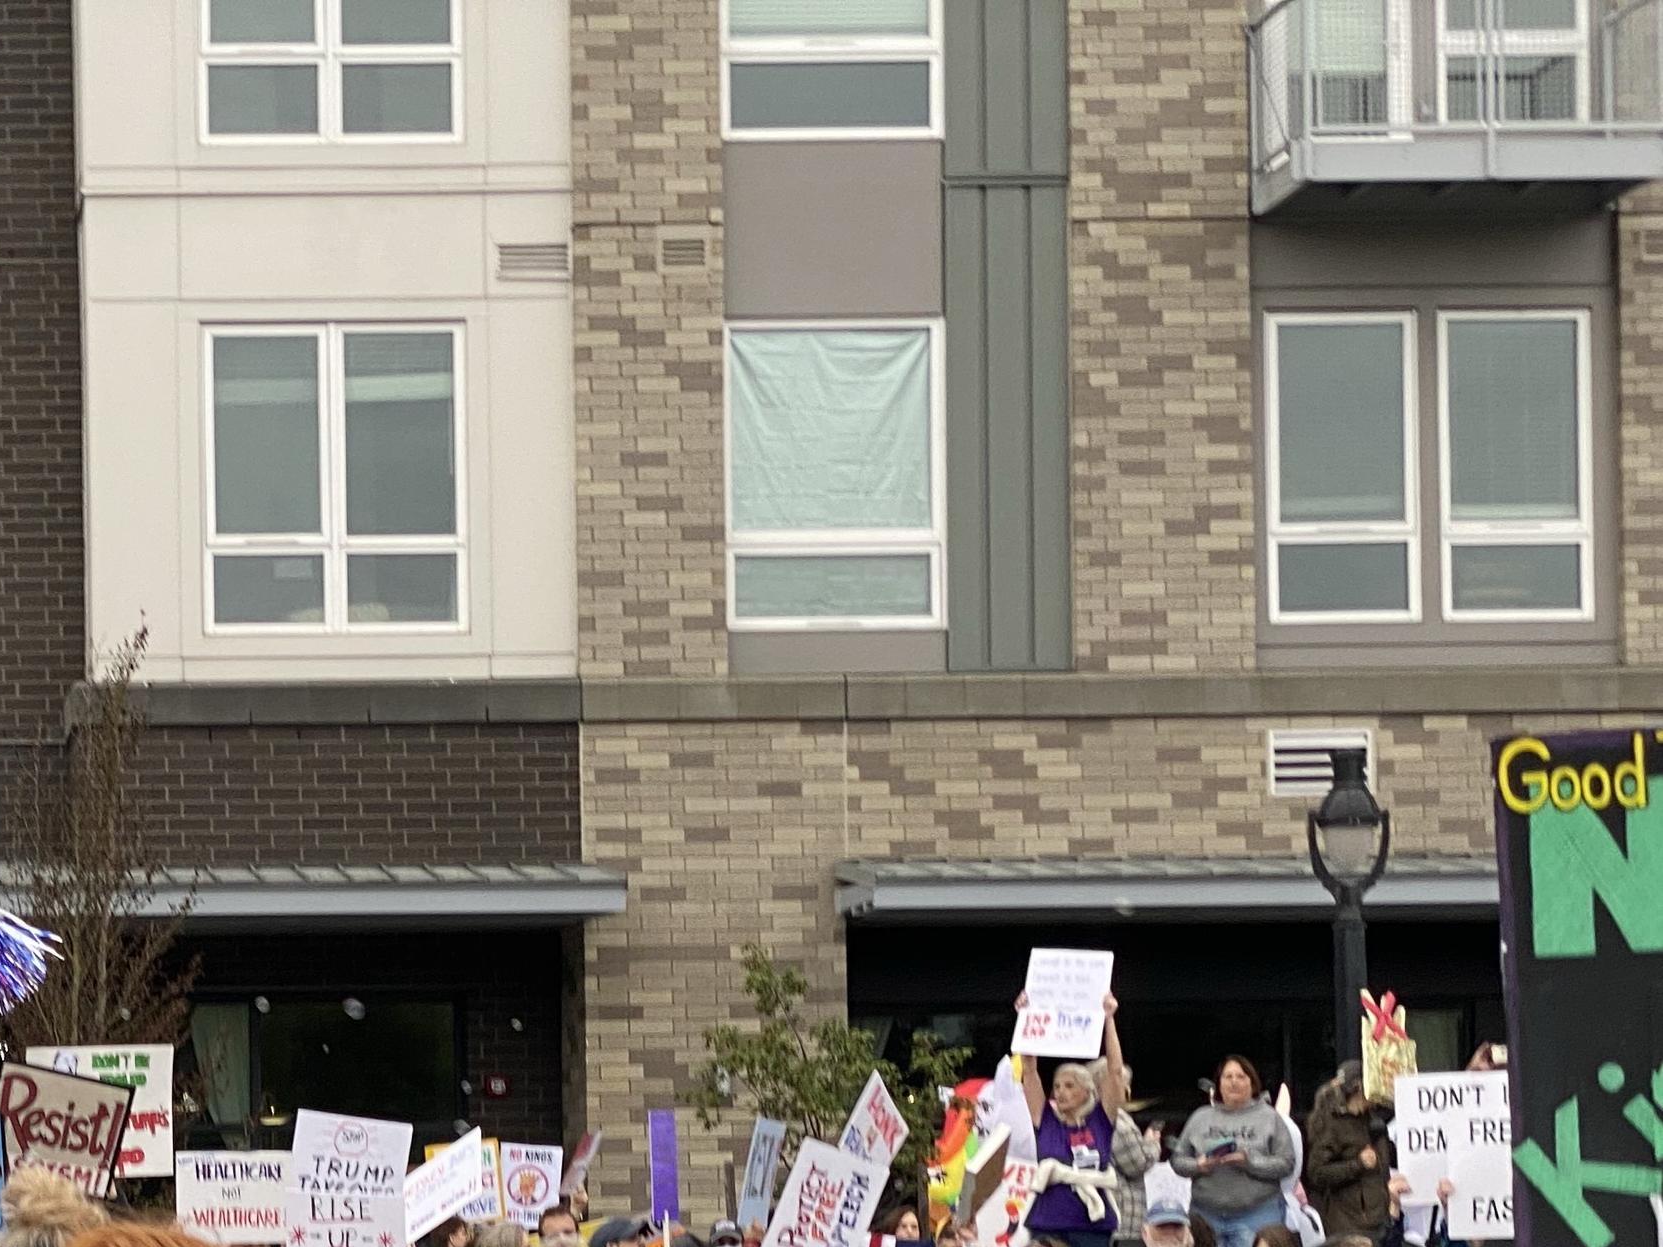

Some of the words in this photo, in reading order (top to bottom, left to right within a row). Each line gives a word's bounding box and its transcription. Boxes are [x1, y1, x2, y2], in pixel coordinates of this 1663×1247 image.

[1497, 731, 1648, 814] Good
[1417, 1083, 1485, 1112] DON'T
[0, 1071, 125, 1170] Resist!
[312, 1154, 395, 1185] TRUMP
[509, 1149, 523, 1162] NO
[310, 1195, 372, 1222] RISE
